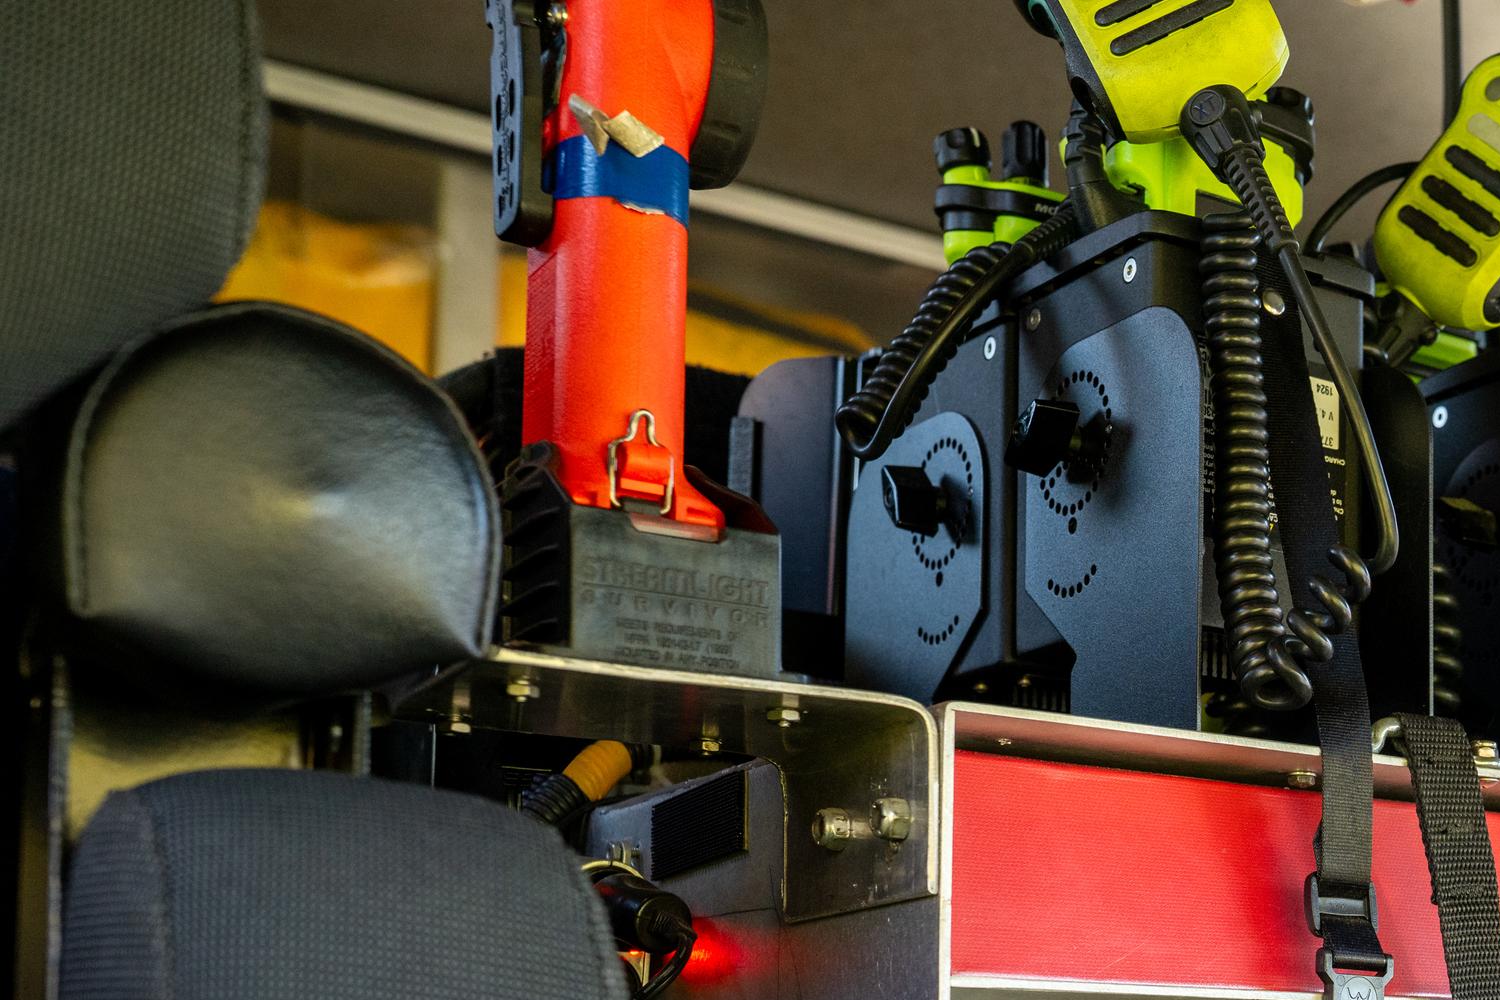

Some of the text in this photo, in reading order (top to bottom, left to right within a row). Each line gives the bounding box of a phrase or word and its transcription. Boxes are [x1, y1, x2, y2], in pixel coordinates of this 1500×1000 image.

[1316, 383, 1333, 396] 1924
[582, 557, 769, 605] STREAMLIGHT
[580, 589, 769, 628] SURVIVOR
